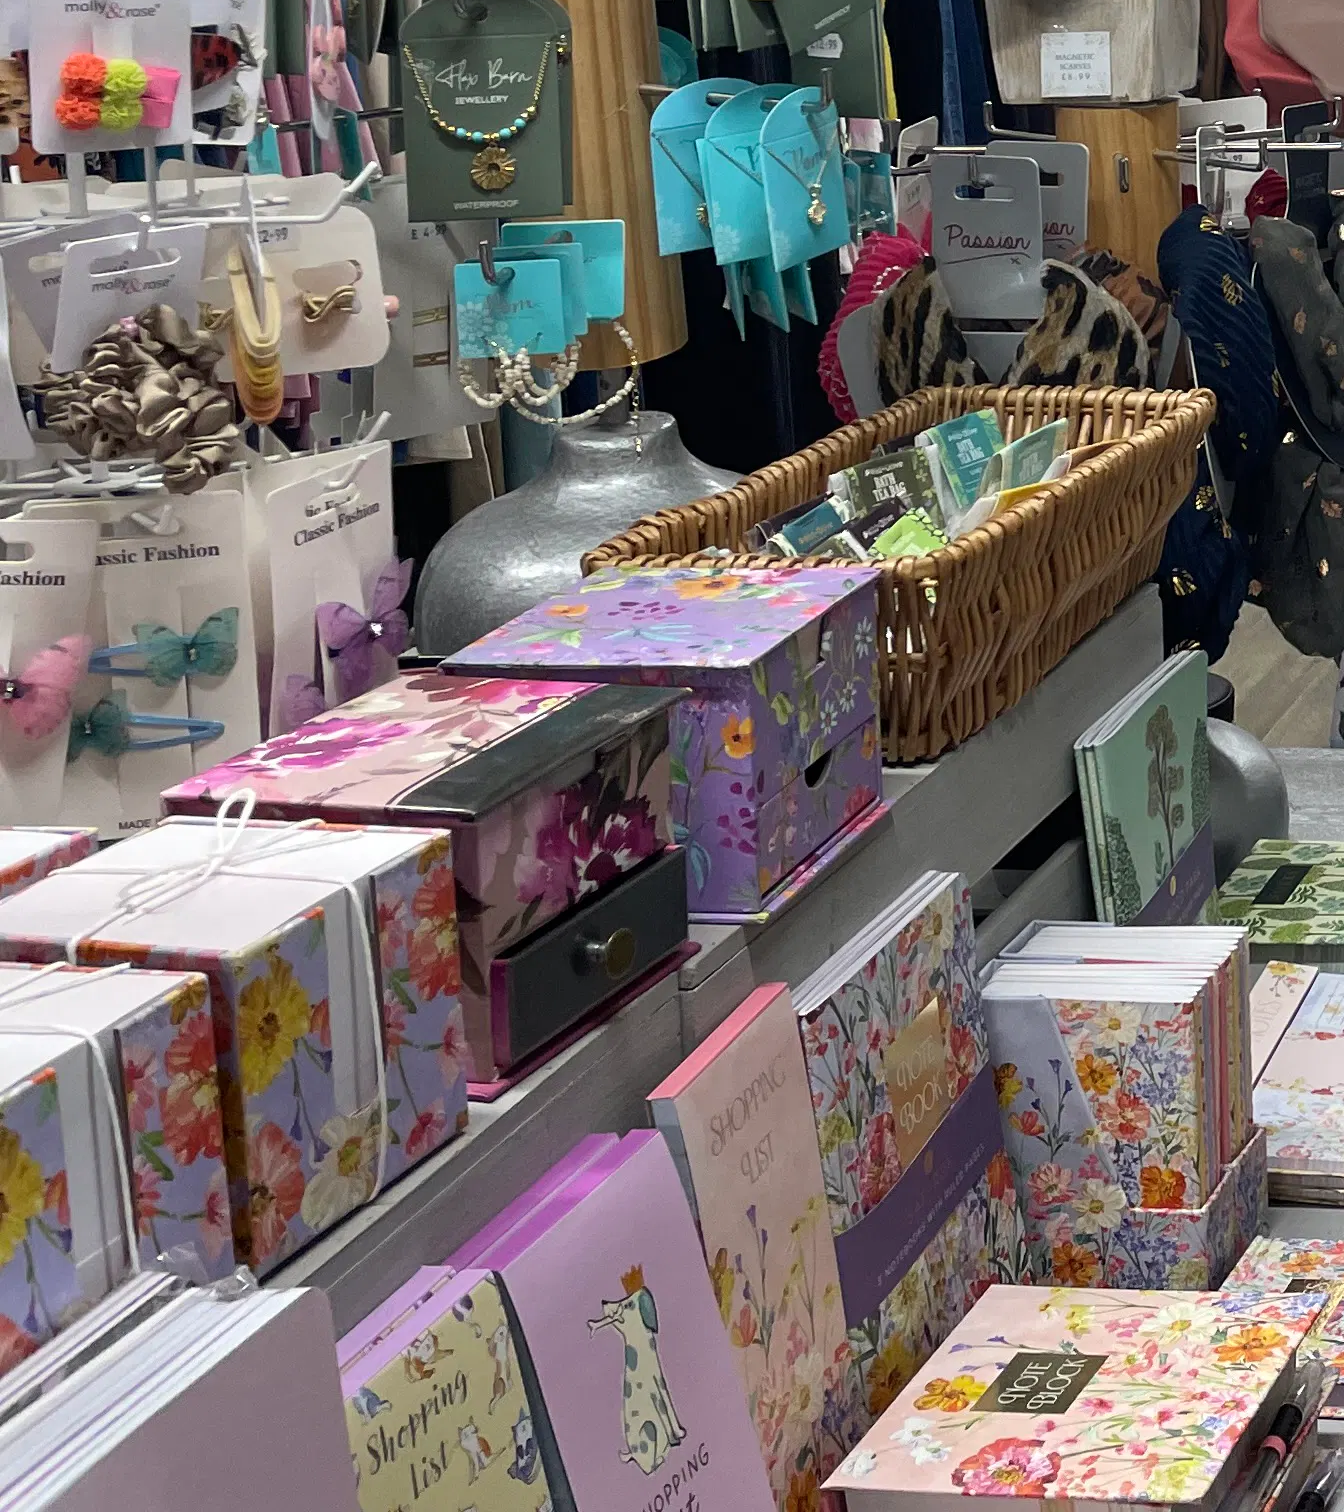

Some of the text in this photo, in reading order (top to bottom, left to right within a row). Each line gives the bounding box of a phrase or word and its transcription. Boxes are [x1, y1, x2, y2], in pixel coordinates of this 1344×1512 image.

[487, 57, 533, 89] Barn
[454, 95, 510, 105] JEWELLERY
[453, 199, 520, 210] WATERPROOF
[943, 223, 1031, 250] Passion
[873, 488, 889, 501] TEA
[874, 473, 896, 486] BATH
[293, 521, 335, 548] Classic
[338, 501, 380, 528] Fashion
[144, 543, 219, 562] Fashion
[0, 572, 66, 587] ashion
[118, 819, 151, 830] MADE
[897, 1034, 937, 1089] NOTE
[709, 1053, 787, 1156] SHOPPING
[900, 1070, 944, 1134] BOOK
[740, 1129, 777, 1185] LIST
[998, 1361, 1053, 1405] NOTE
[1026, 1358, 1088, 1410] BLOCK
[366, 1369, 469, 1474] Shopping
[409, 1440, 451, 1500] List
